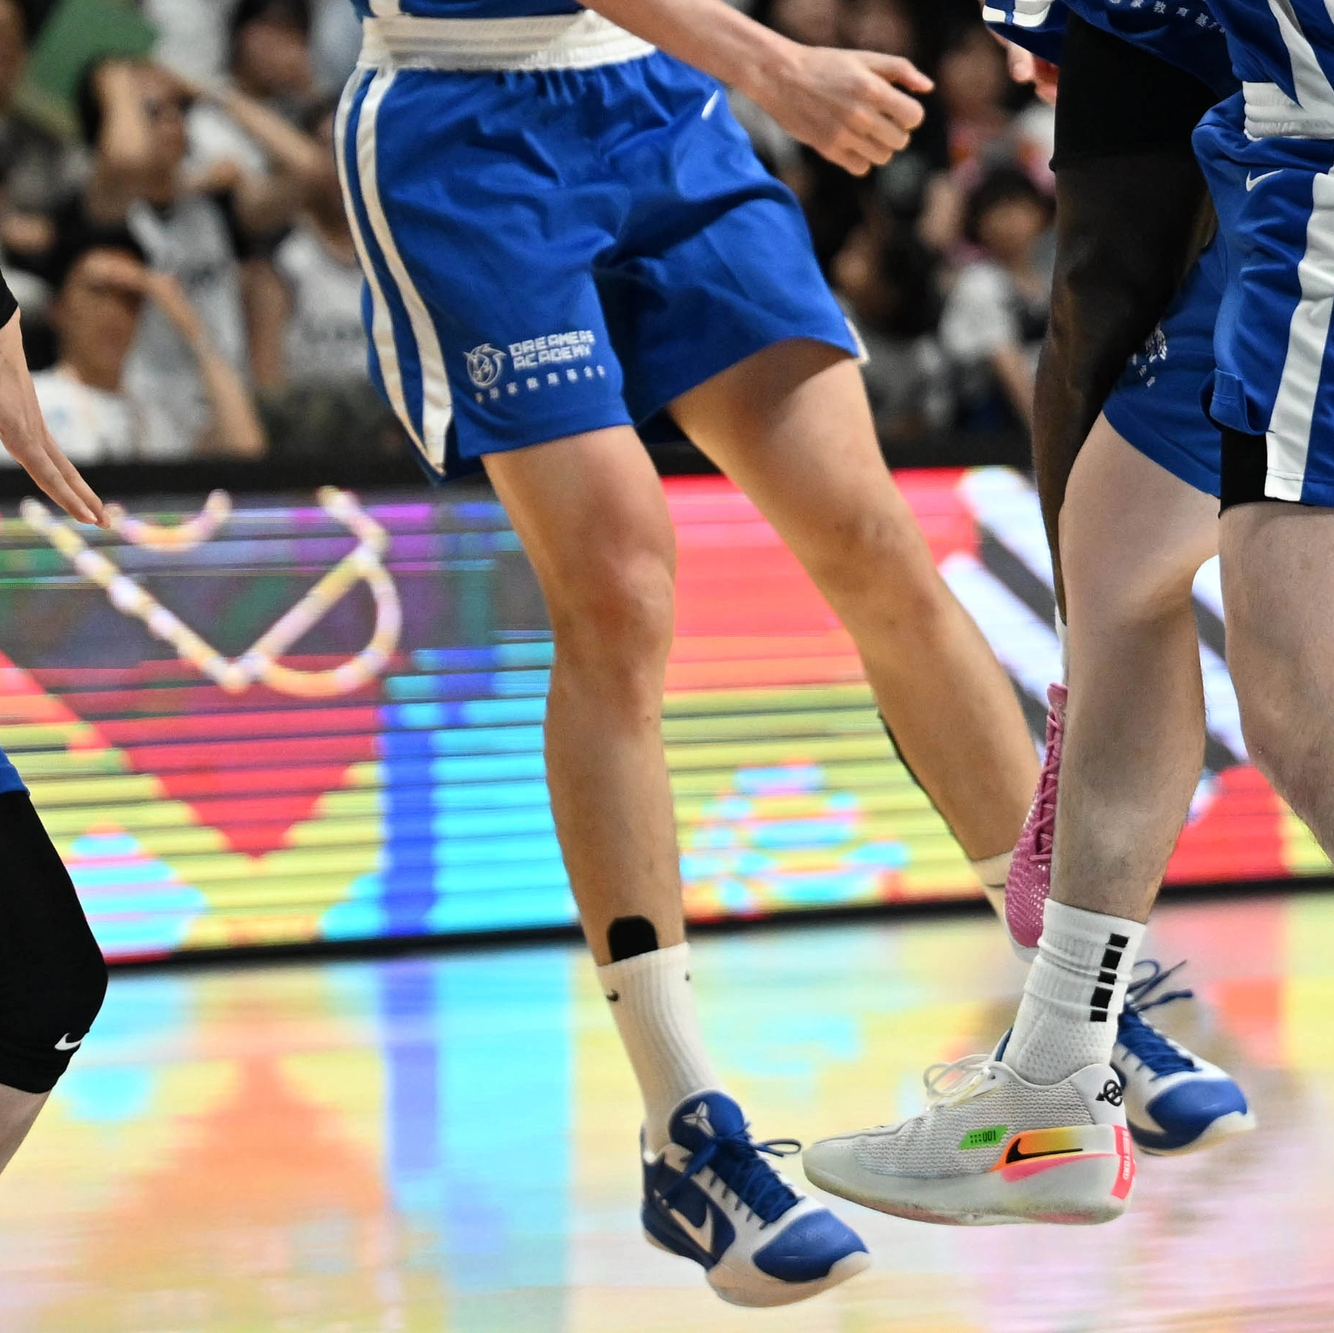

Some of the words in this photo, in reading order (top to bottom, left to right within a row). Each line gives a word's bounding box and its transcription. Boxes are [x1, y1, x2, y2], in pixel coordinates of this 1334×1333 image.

[508, 330, 595, 358] DREAMERS
[513, 344, 591, 370] ACADEMY
[982, 1129, 997, 1143] 001
